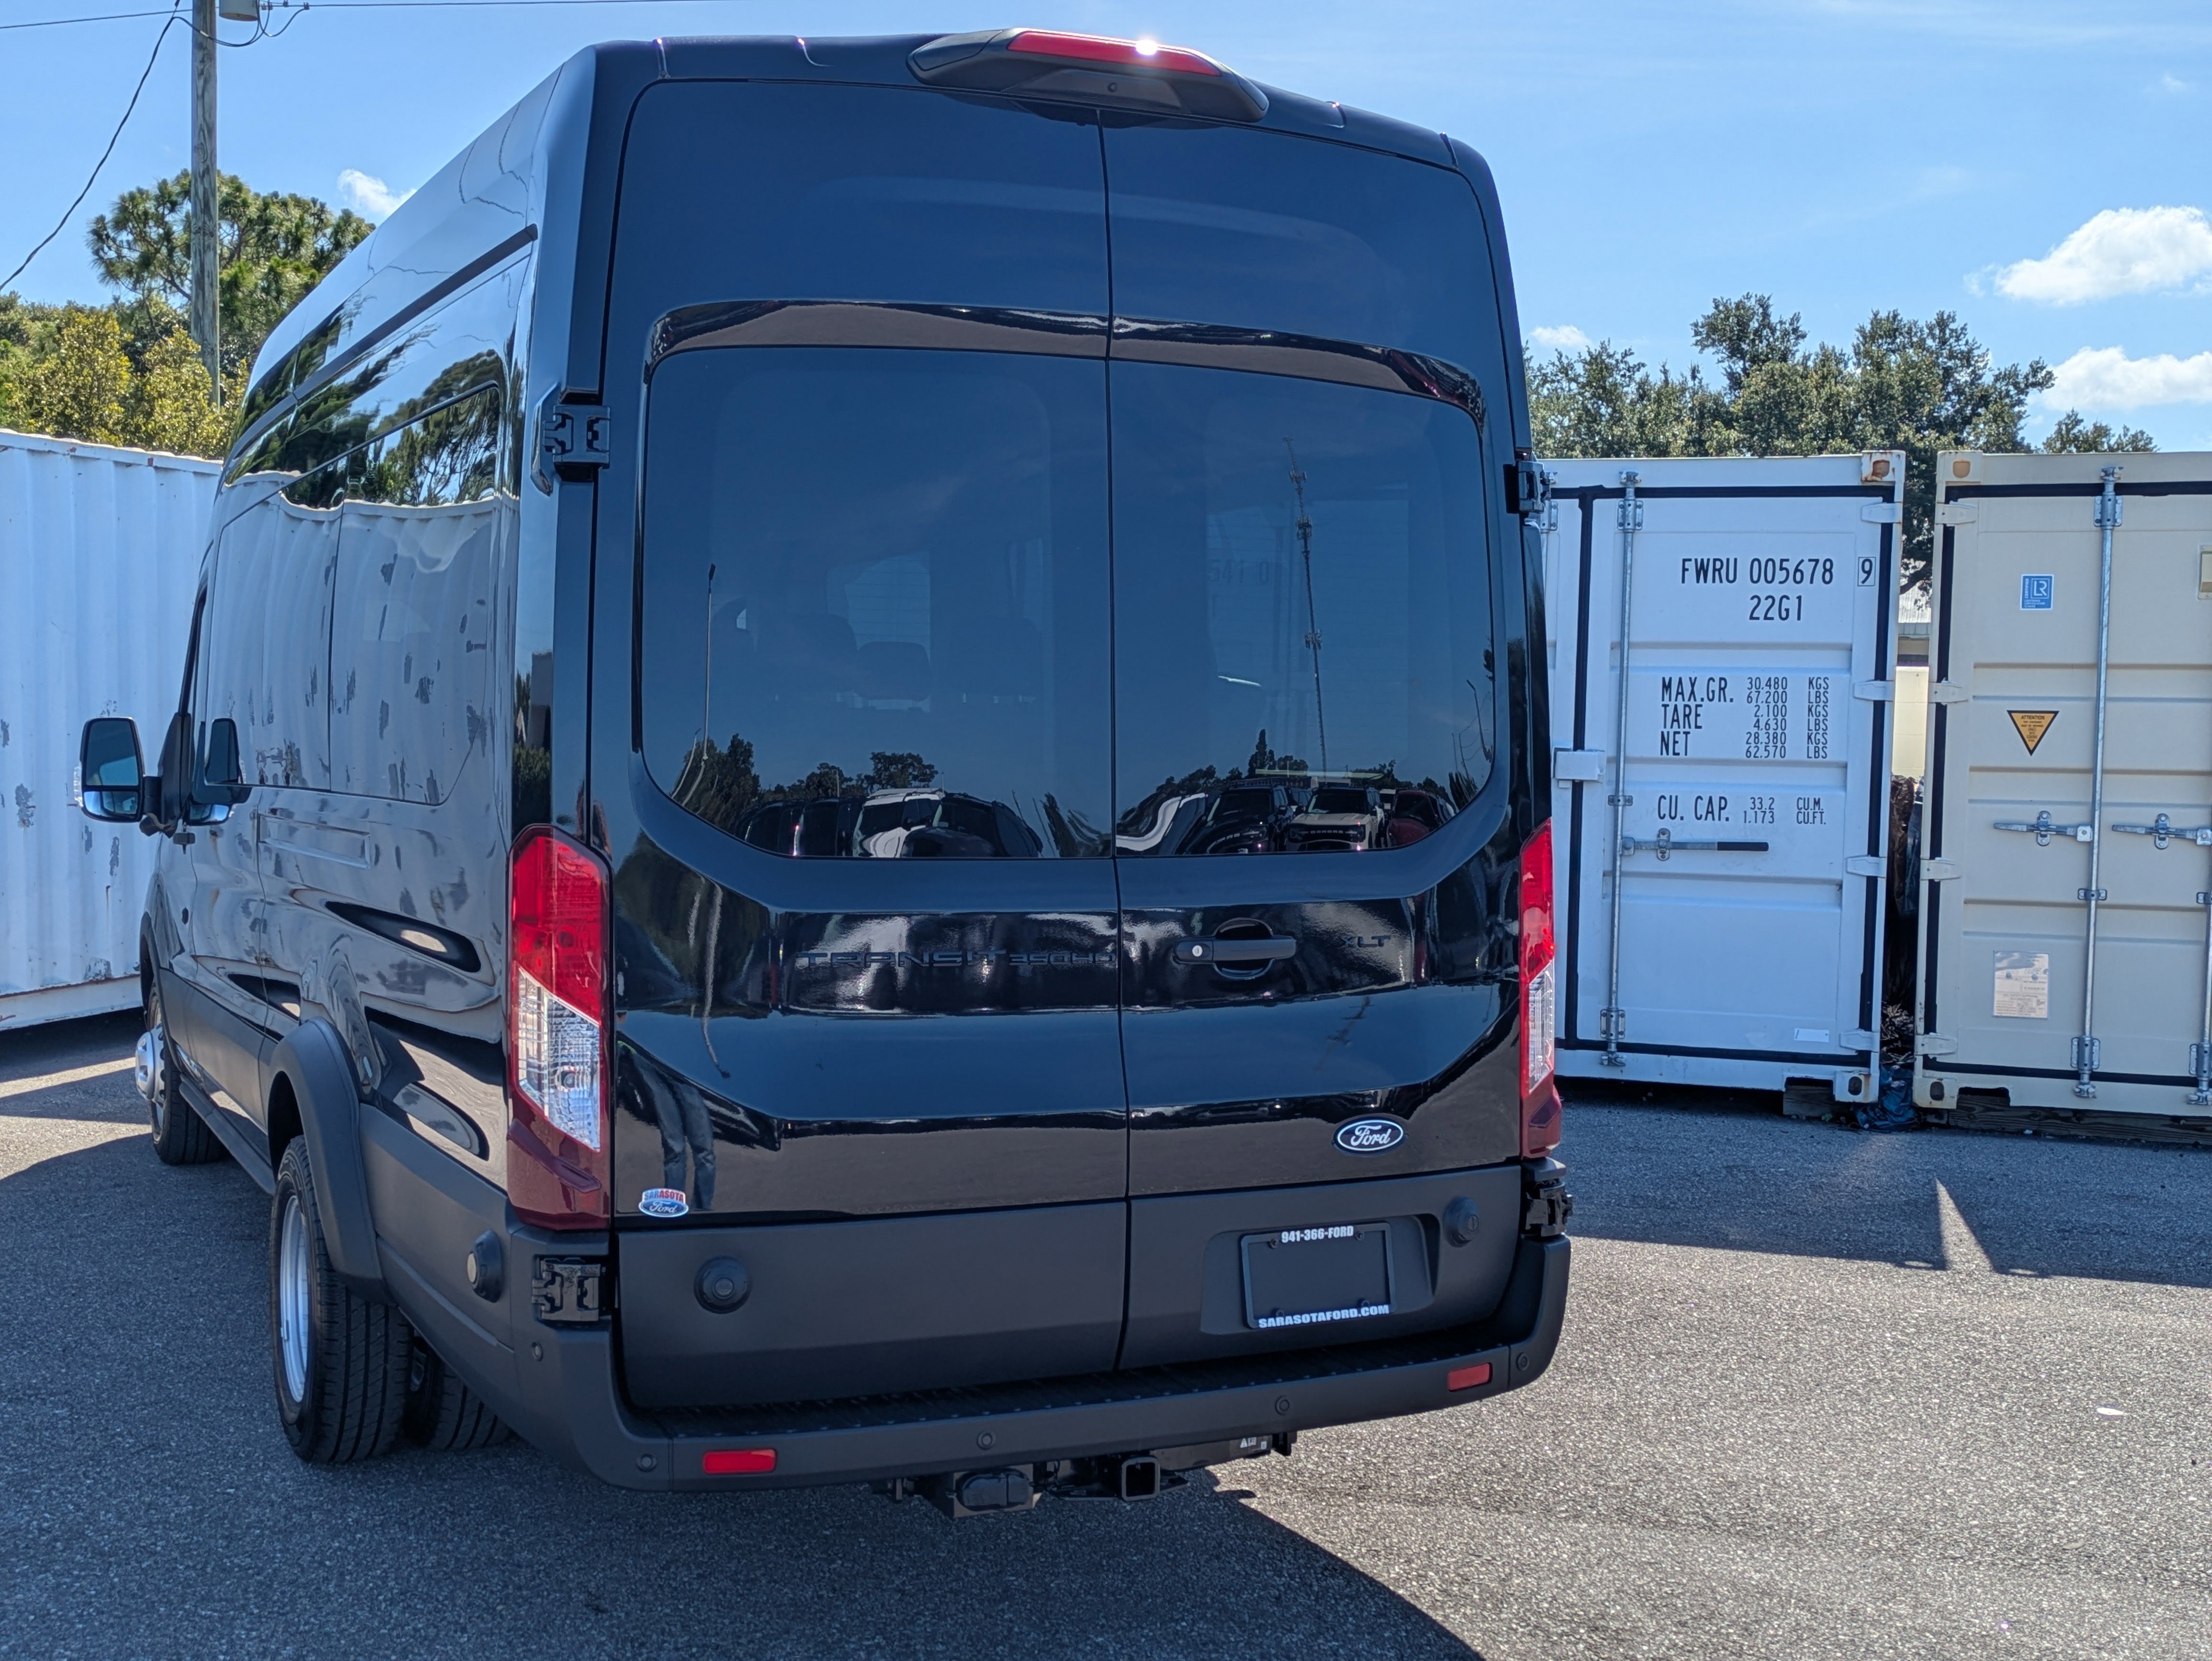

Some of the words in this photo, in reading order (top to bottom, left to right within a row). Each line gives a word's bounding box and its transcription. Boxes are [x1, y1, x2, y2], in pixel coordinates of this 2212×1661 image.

[1681, 557, 1737, 584] FWRU
[1749, 558, 1834, 585] 005678
[1861, 558, 1873, 584] 9
[2034, 580, 2047, 596] LR
[1749, 595, 1802, 621] 22G1
[1661, 676, 1734, 703] MAX.GR.
[1808, 676, 1829, 690] KGS
[1808, 690, 1829, 704] LBS
[1661, 704, 1703, 729] TARE
[1808, 704, 1829, 718] KGS
[1807, 718, 1828, 731] LBS
[1660, 731, 1691, 756] NET
[1807, 731, 1828, 745] KGS
[1807, 745, 1827, 759] LBS
[1658, 795, 1684, 820] CU.
[1694, 795, 1729, 821] CAP.
[1750, 797, 1775, 810] 33.2
[1338, 935, 1391, 948] XLT
[795, 951, 1006, 967] TRANSIT
[1350, 1124, 1391, 1146] Ford
[644, 1190, 684, 1203] SARASOTA
[650, 1201, 677, 1213] Ford
[1281, 1225, 1354, 1243] 941-366-FORD
[1258, 1304, 1389, 1329] SARASOTAFORD.COM
